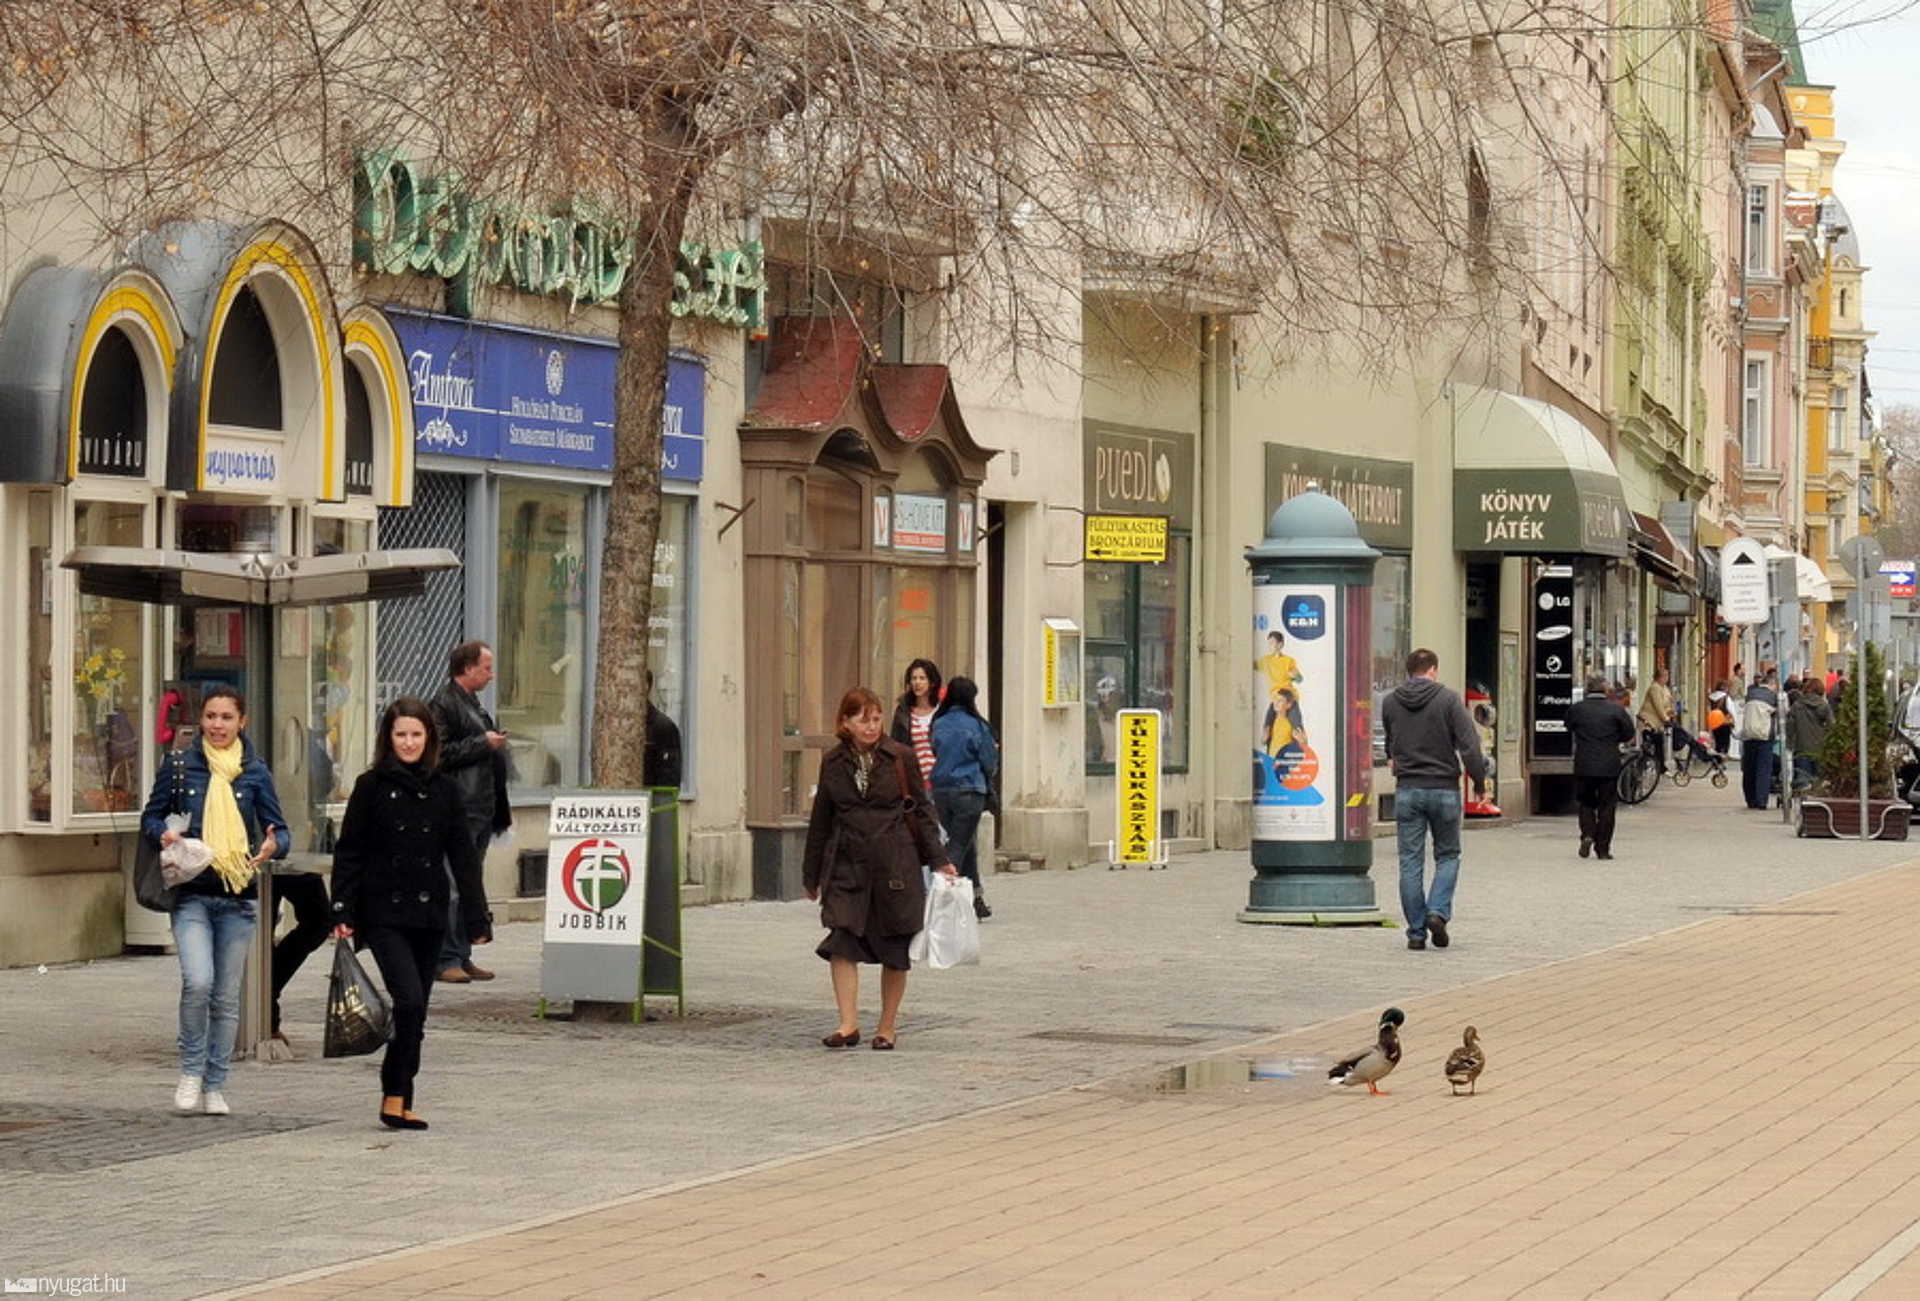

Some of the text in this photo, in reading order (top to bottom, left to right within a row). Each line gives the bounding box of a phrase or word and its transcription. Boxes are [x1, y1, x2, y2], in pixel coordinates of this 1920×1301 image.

[1480, 488, 1552, 513] KÖNYV
[1484, 515, 1545, 544] JÁTÉK
[1556, 595, 1571, 607] LG
[1287, 617, 1319, 627] K&H
[555, 821, 642, 833] VÁLTOZÁST!
[559, 912, 627, 931] JOBBIK
